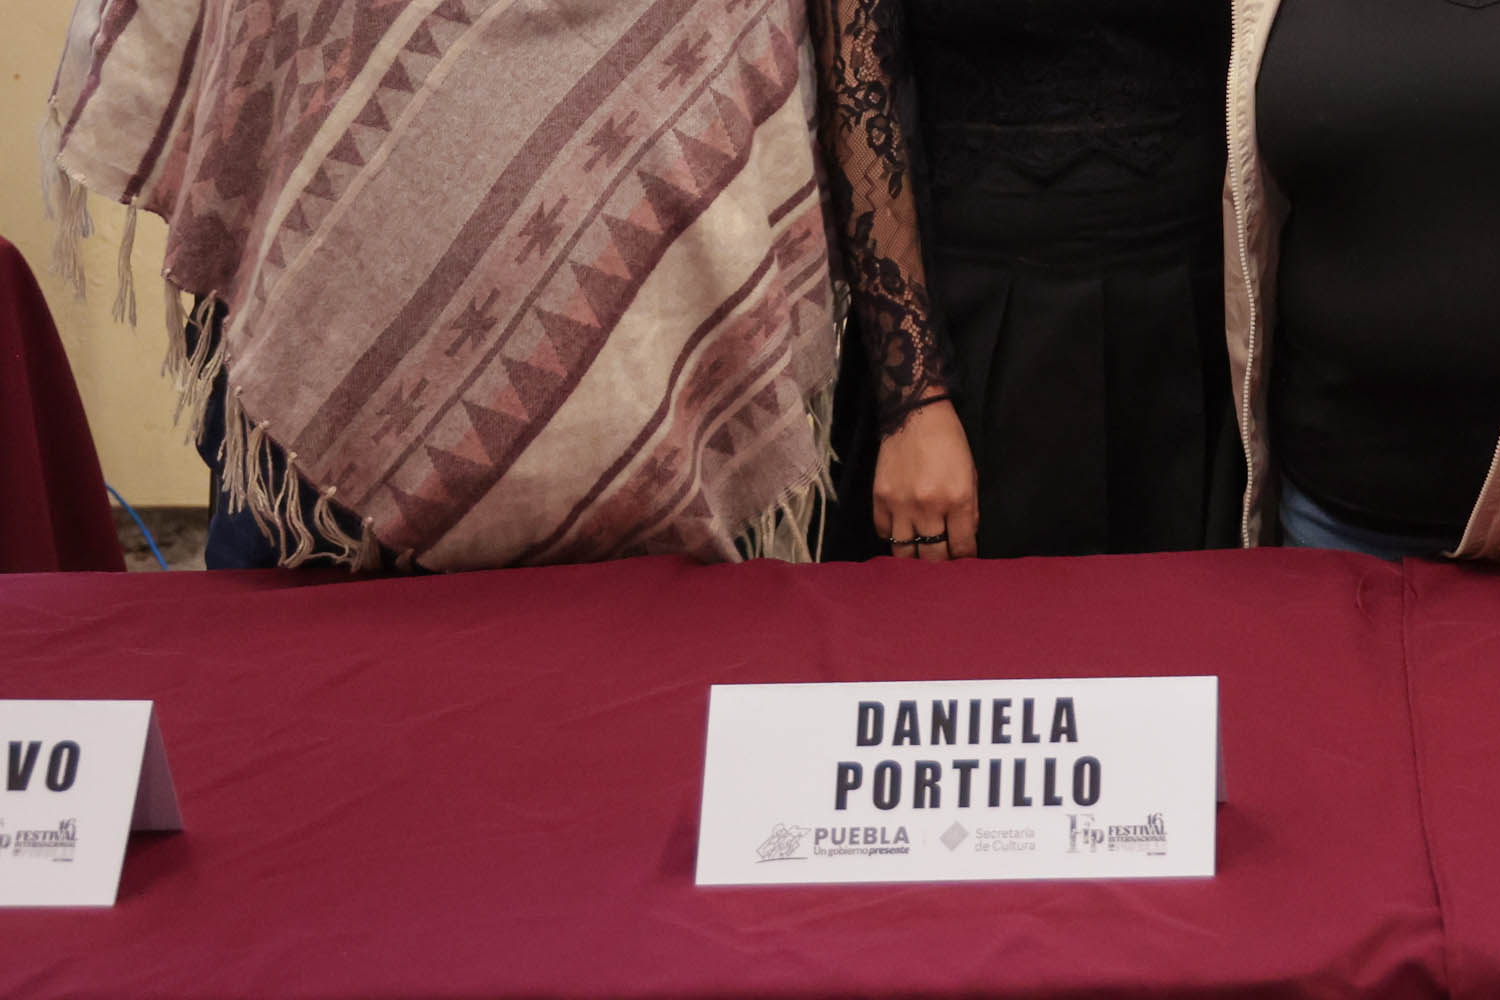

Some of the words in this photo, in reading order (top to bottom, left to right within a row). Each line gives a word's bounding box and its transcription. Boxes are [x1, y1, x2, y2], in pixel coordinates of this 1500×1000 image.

[856, 697, 1078, 746] DANIELA
[6, 740, 81, 792] VO
[834, 755, 1101, 810] PORTILLO
[814, 826, 910, 846] PUEBLA
[1108, 825, 1168, 836] FESTIVAL
